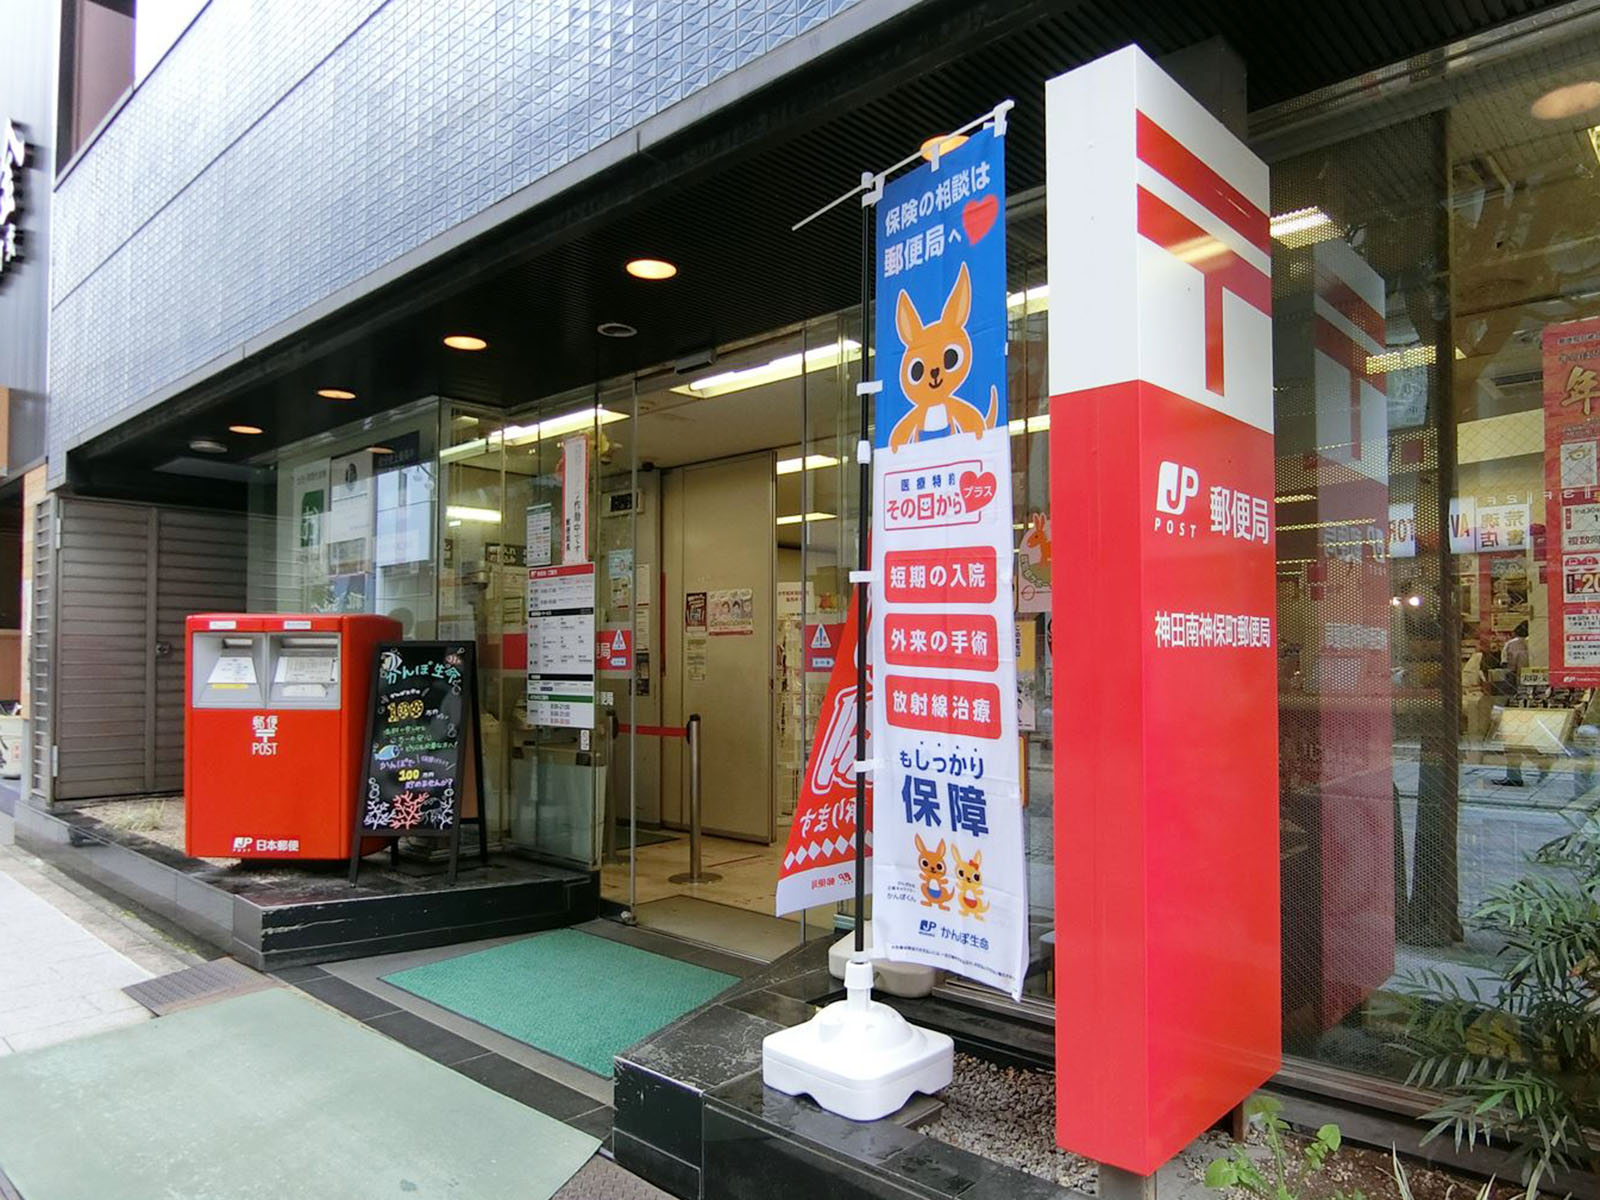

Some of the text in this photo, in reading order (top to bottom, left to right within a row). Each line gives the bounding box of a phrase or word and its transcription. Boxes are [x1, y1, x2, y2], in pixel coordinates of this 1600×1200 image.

[885, 161, 991, 237] 保険の相談は
[884, 223, 962, 278] 郵便局へ
[963, 485, 993, 498] プラス
[886, 492, 962, 521] その日から
[1210, 486, 1270, 545] 郵便局
[1154, 517, 1197, 539] POST
[890, 562, 986, 588] 短期の入院
[891, 628, 988, 656] 外来の手術
[1155, 611, 1270, 649] 神田南神保町郵便局
[892, 690, 990, 723] 放射線治療
[252, 715, 279, 731] 郵便
[251, 742, 279, 755] POST
[398, 769, 420, 782] 100
[901, 774, 989, 838] 保障
[255, 839, 299, 852] 日本郵便
[941, 926, 990, 951] かんぽ生命
